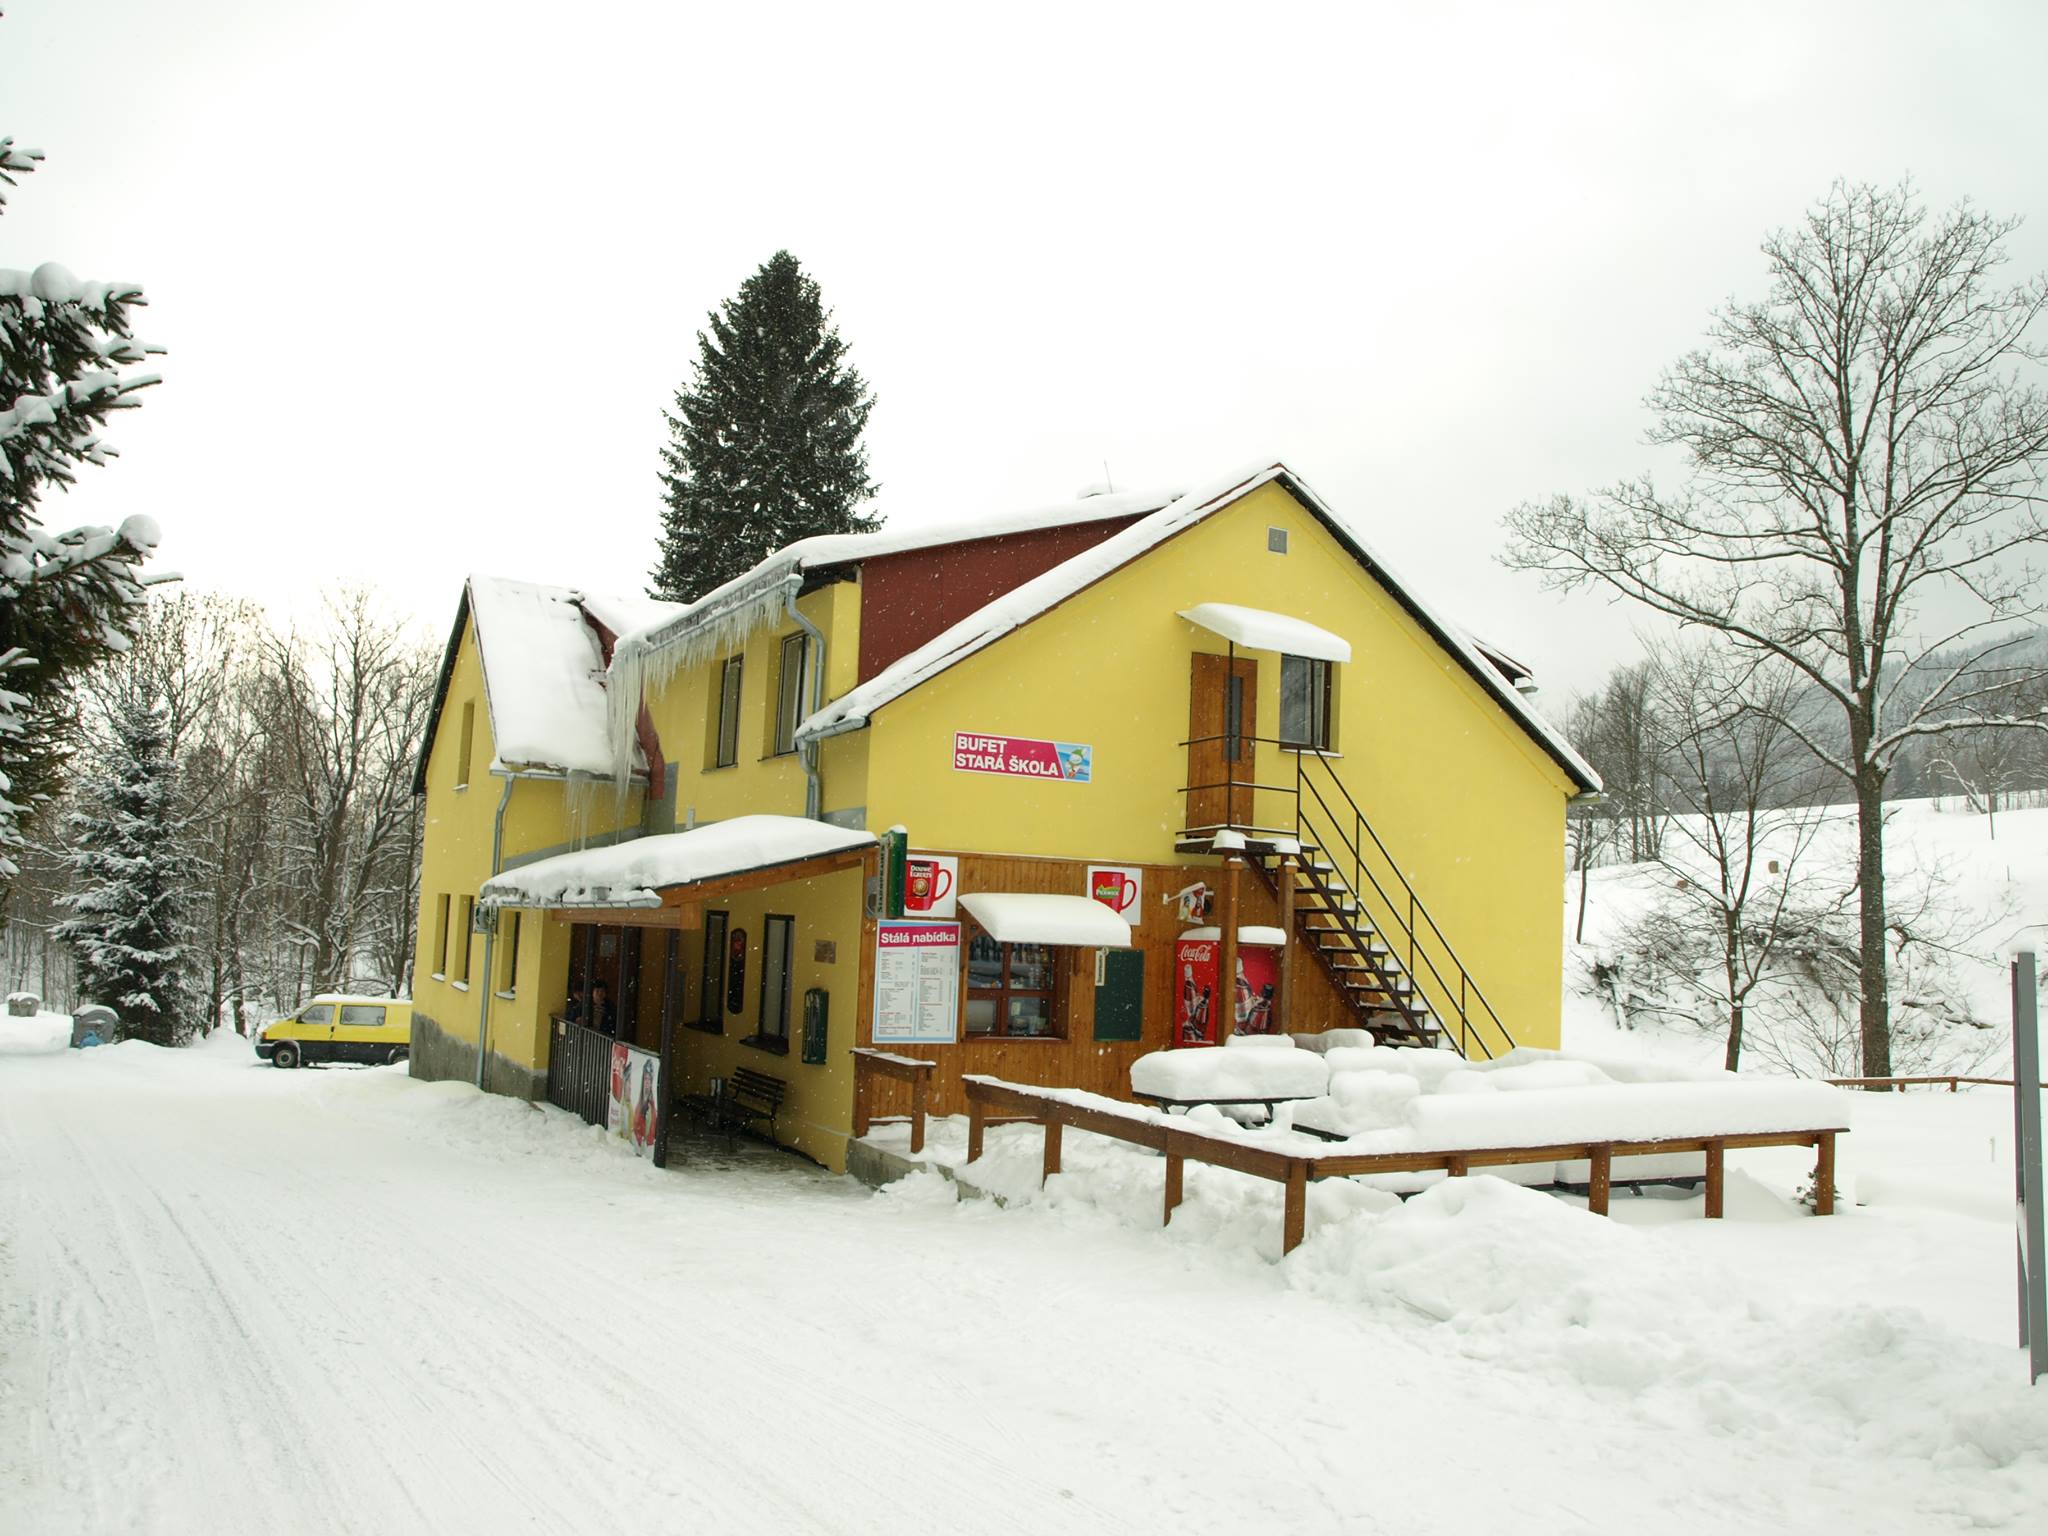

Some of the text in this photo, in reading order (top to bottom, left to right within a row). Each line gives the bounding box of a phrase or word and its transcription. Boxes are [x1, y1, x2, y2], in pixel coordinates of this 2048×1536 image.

[957, 736, 1007, 753] BUFET
[956, 753, 1059, 776] STARÁ ŠKOLA
[881, 931, 956, 944] Stálá nabídka
